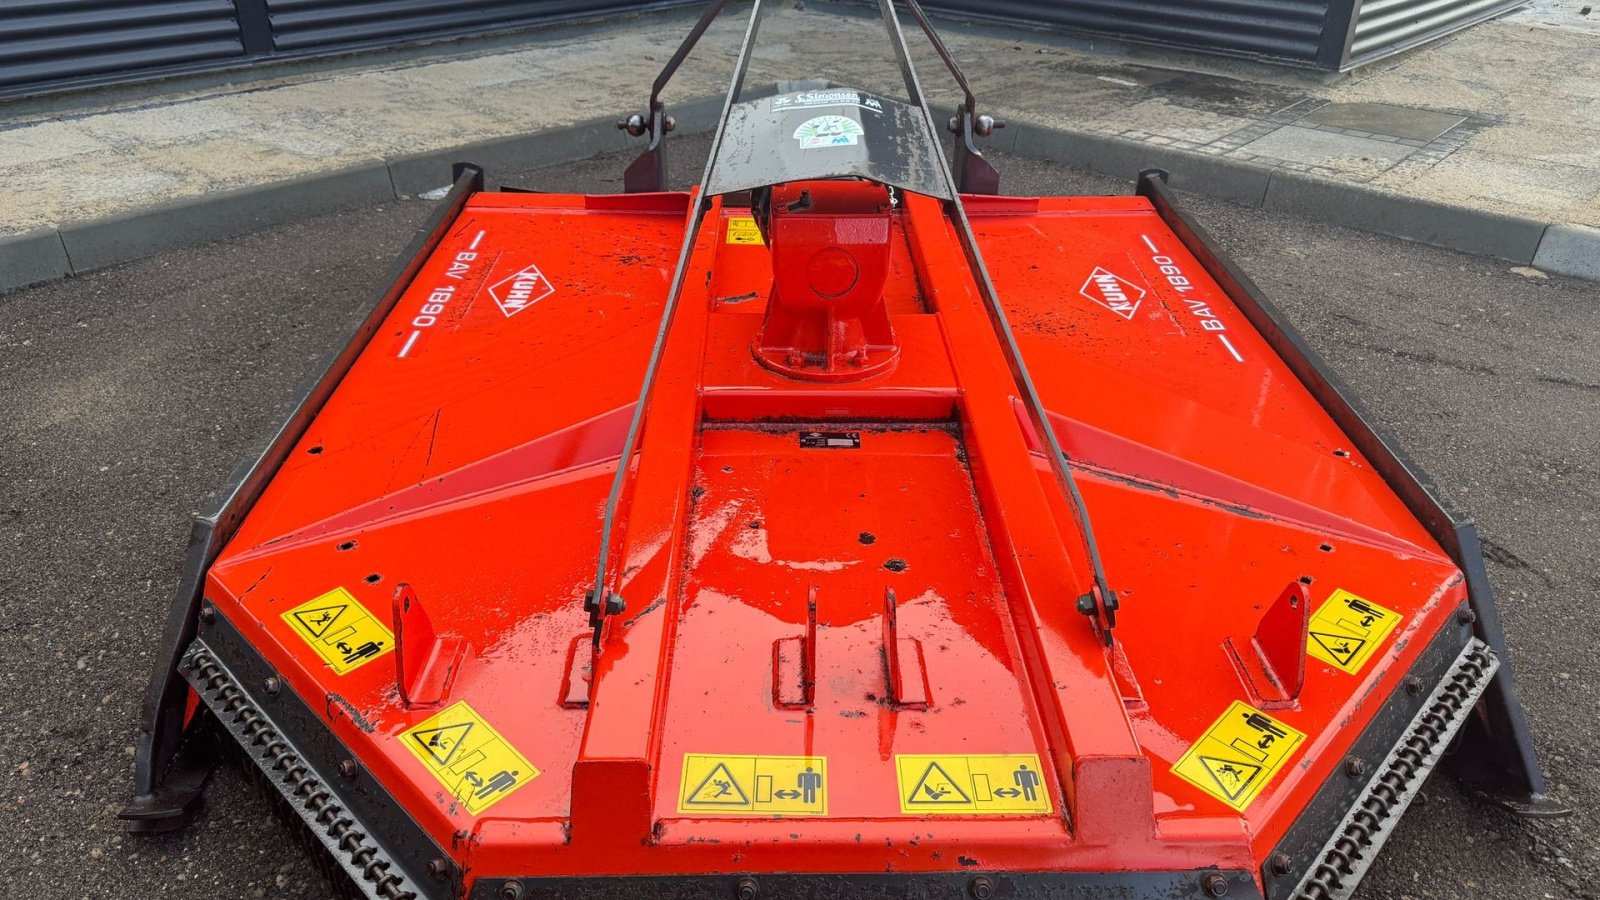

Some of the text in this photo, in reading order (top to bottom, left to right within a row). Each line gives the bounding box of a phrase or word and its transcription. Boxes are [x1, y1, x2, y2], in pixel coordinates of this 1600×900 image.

[413, 252, 477, 326] BAV 1890
[504, 271, 541, 310] KUHN
[1093, 274, 1133, 312] KUHN
[1153, 255, 1225, 330] BAV 1890
